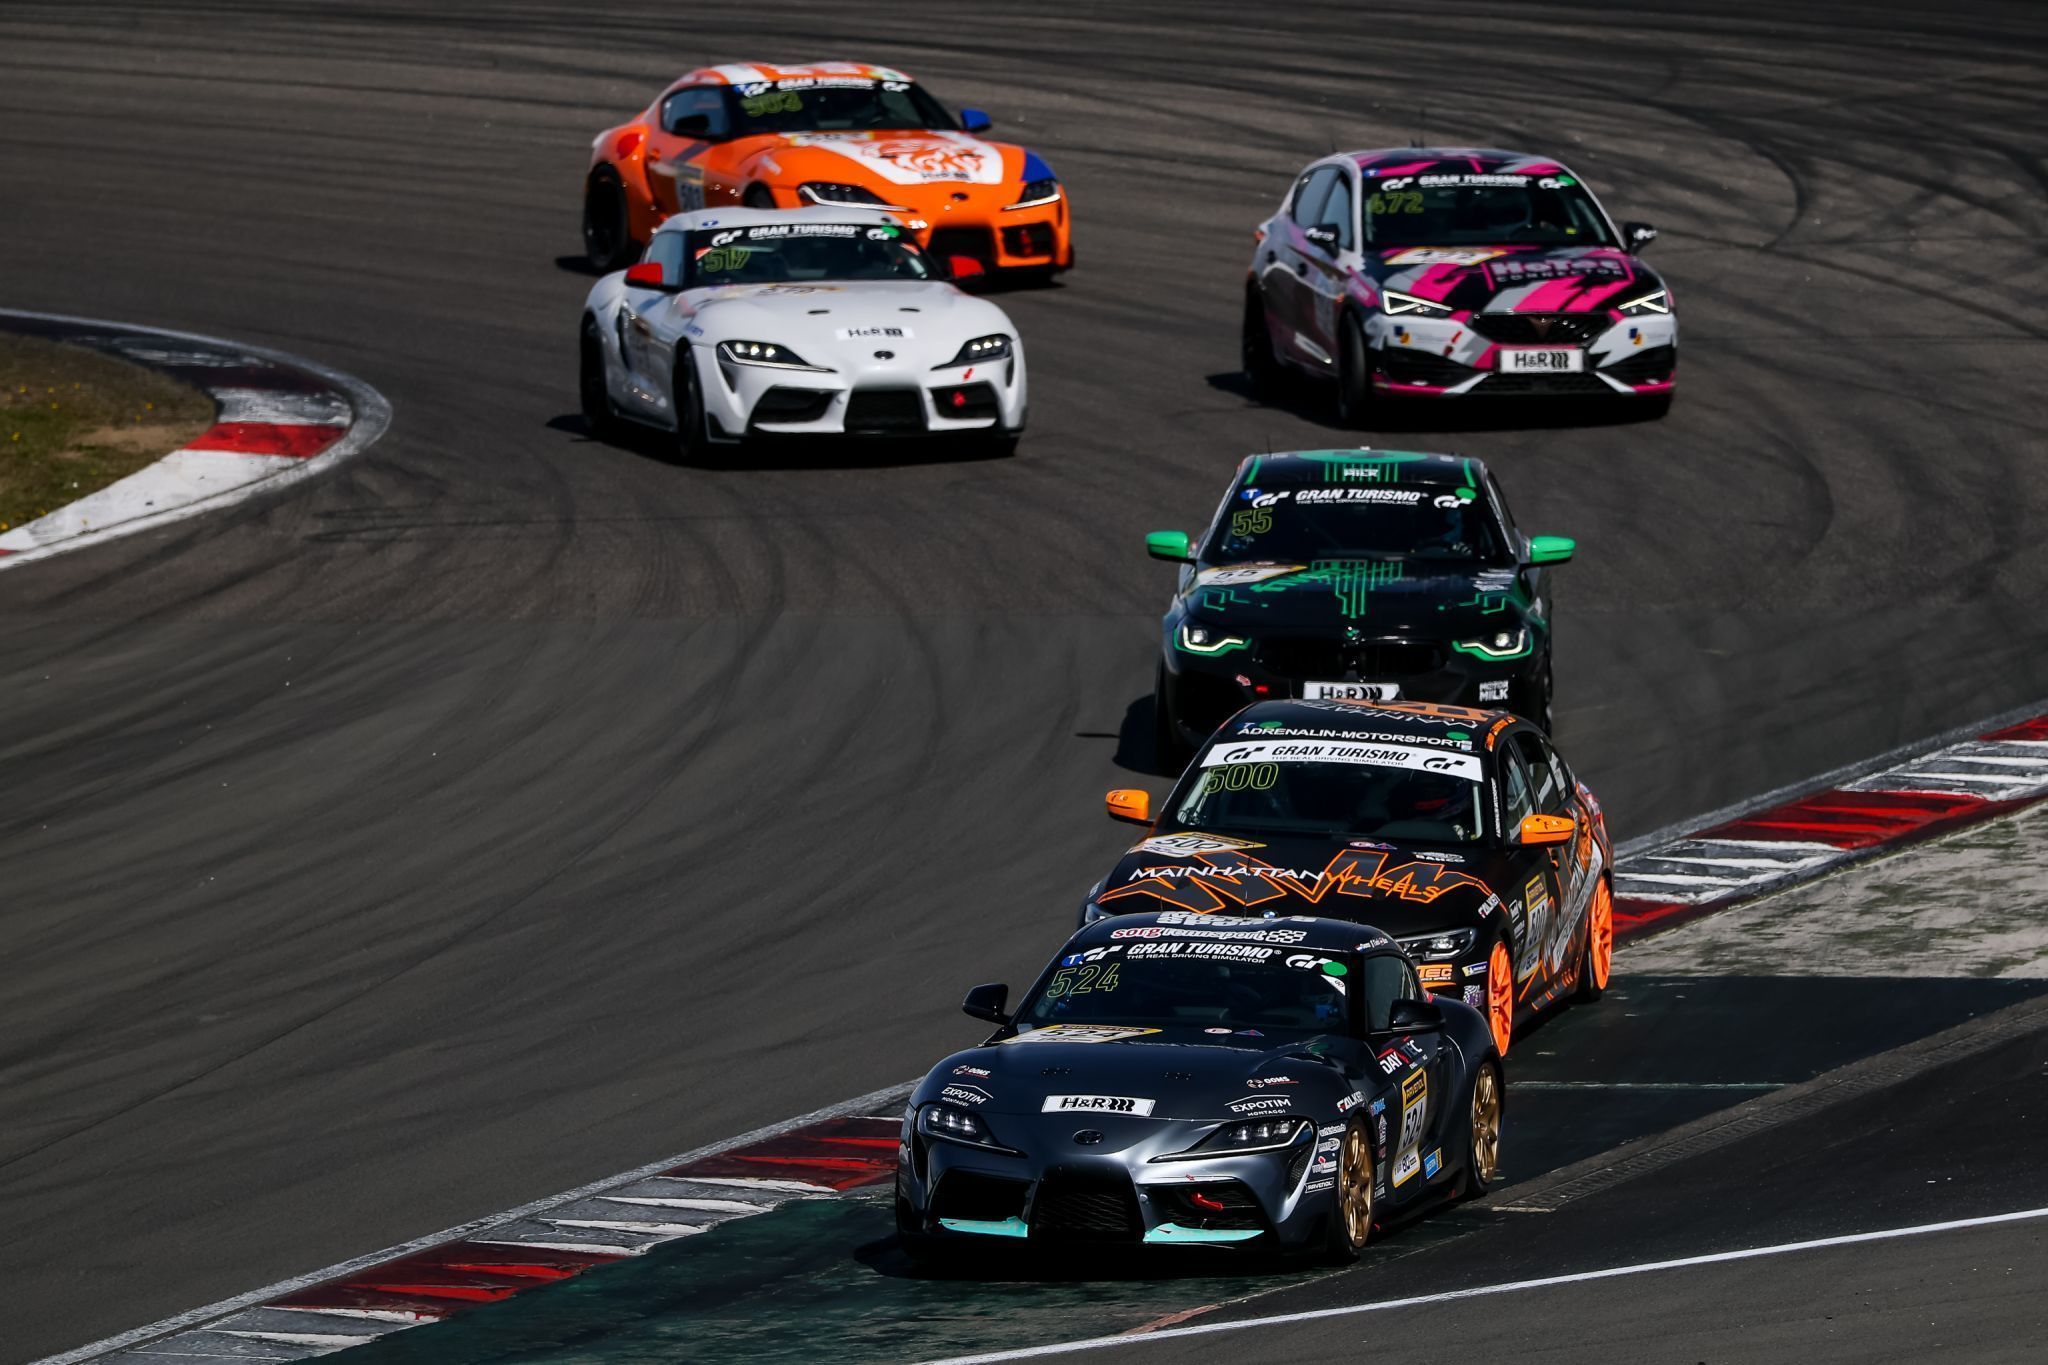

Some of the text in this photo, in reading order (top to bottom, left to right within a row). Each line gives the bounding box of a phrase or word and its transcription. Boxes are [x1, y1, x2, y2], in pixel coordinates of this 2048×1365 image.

[1369, 192, 1424, 214] 672
[749, 226, 789, 238] GRAN
[1515, 353, 1546, 368] H&R
[1296, 488, 1421, 501] GRAN TURISMO
[1232, 507, 1272, 536] 55
[1272, 746, 1410, 761] GRAN TURISMO
[1202, 763, 1279, 794] 500
[1156, 837, 1224, 849] 500
[1128, 861, 1441, 899] MAINHATTAN WHEELS
[1127, 942, 1274, 959] GRAN TURISMO
[1211, 954, 1266, 963] SIMULATOR
[1046, 963, 1120, 998] 524
[1040, 1028, 1123, 1039] 524
[1264, 1076, 1290, 1084] OOMS
[941, 1087, 987, 1105] EXPOTIM
[1061, 1097, 1106, 1109] H&R
[1230, 1099, 1291, 1113] EXPOTIM
[1402, 1102, 1424, 1148] 524
